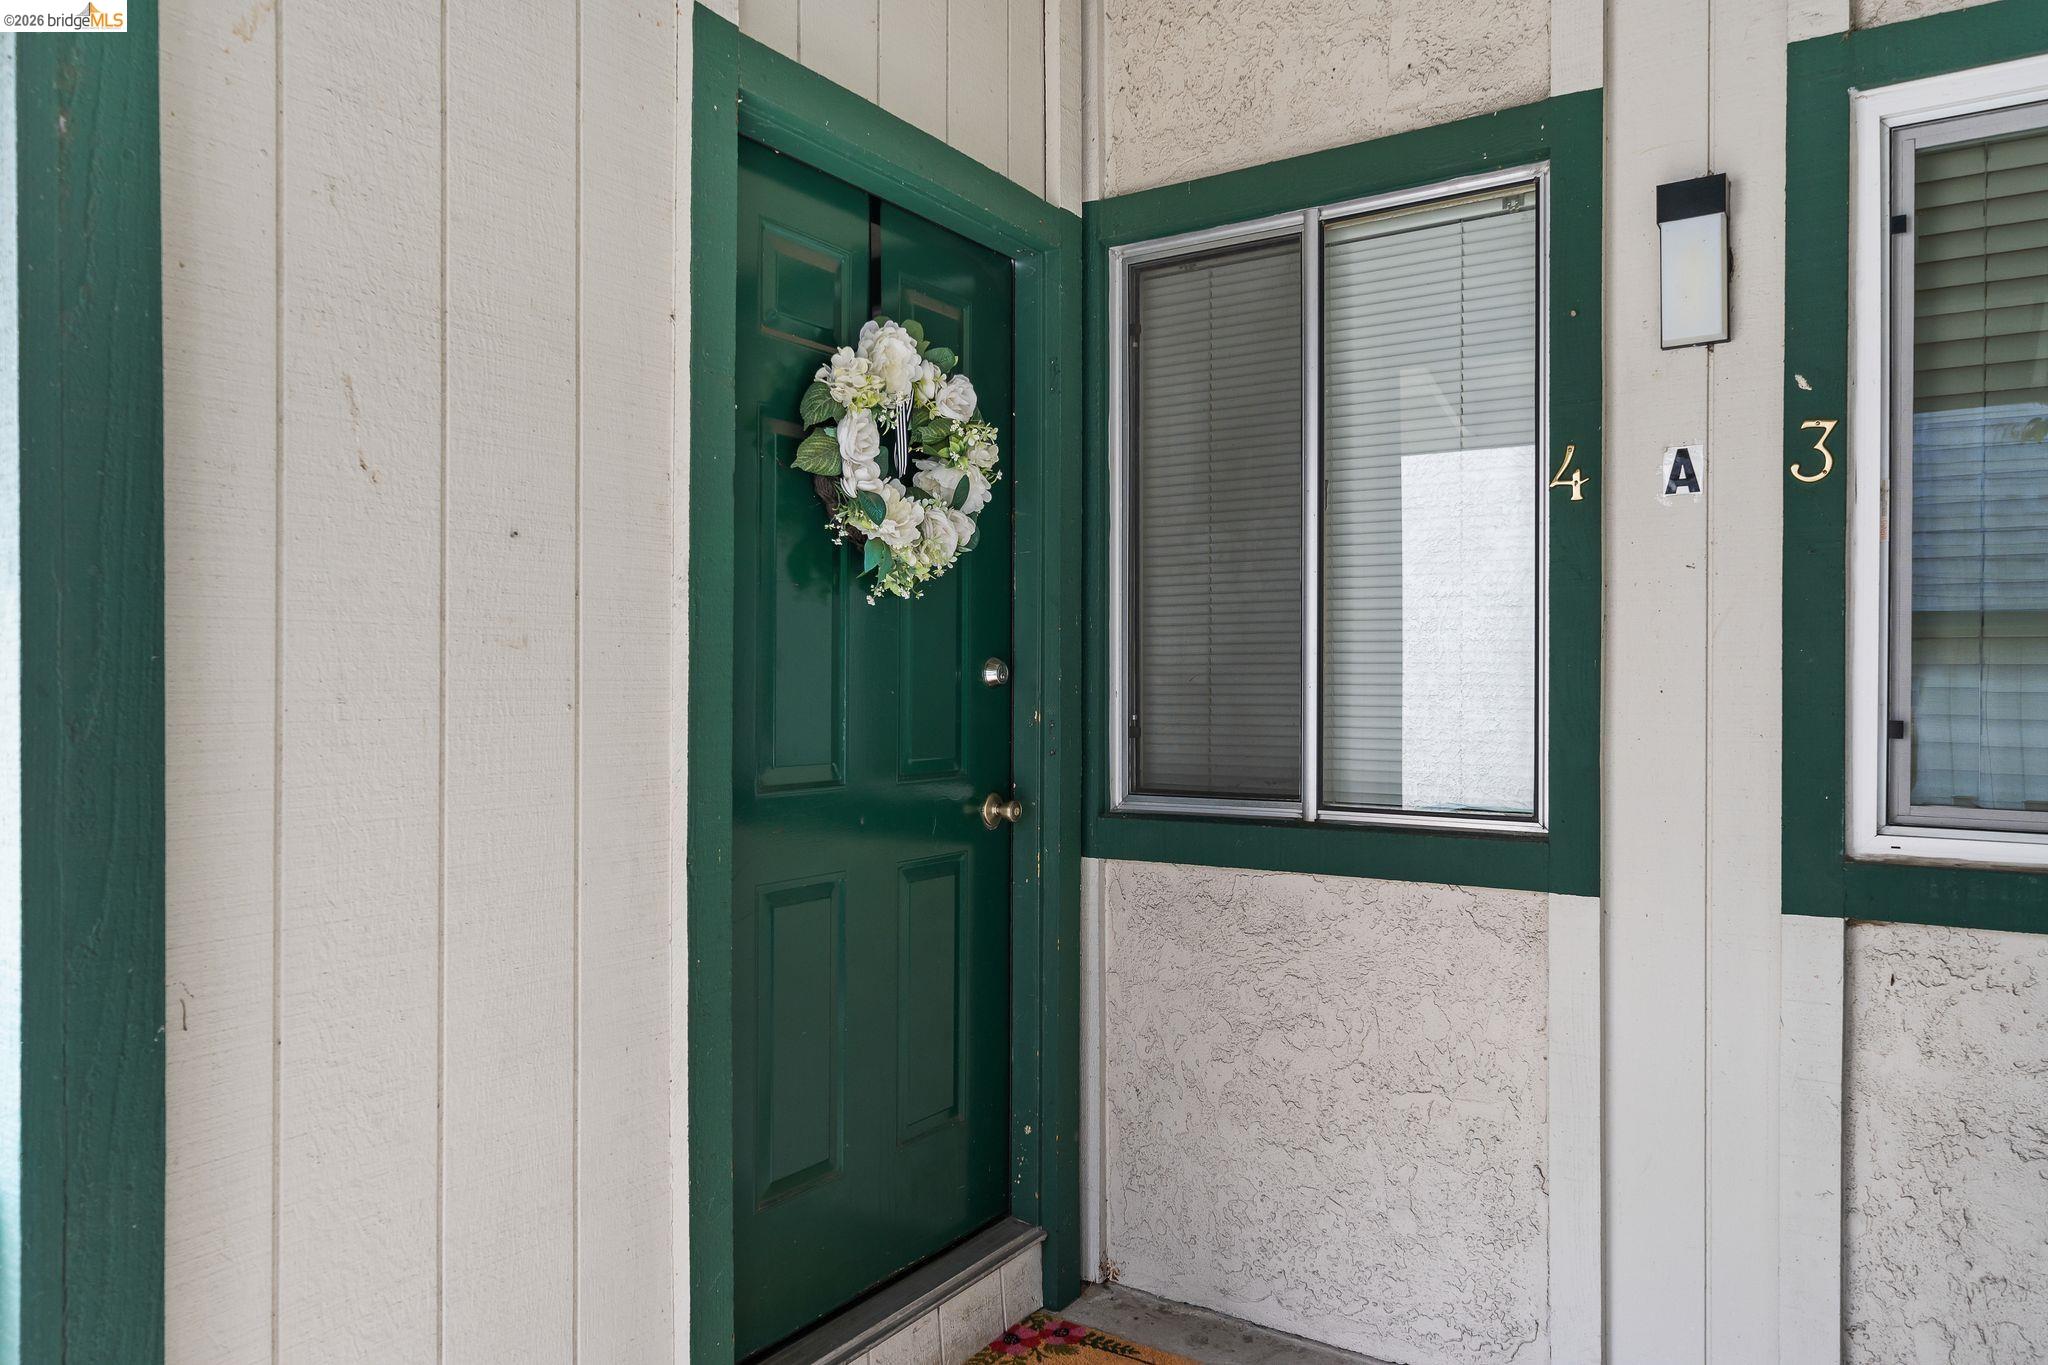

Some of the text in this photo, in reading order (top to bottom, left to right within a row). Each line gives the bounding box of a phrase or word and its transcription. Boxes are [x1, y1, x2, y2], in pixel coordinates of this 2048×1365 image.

[1549, 444, 1590, 501] 4
[1665, 447, 1701, 495] A
[1790, 419, 1838, 483] 3
